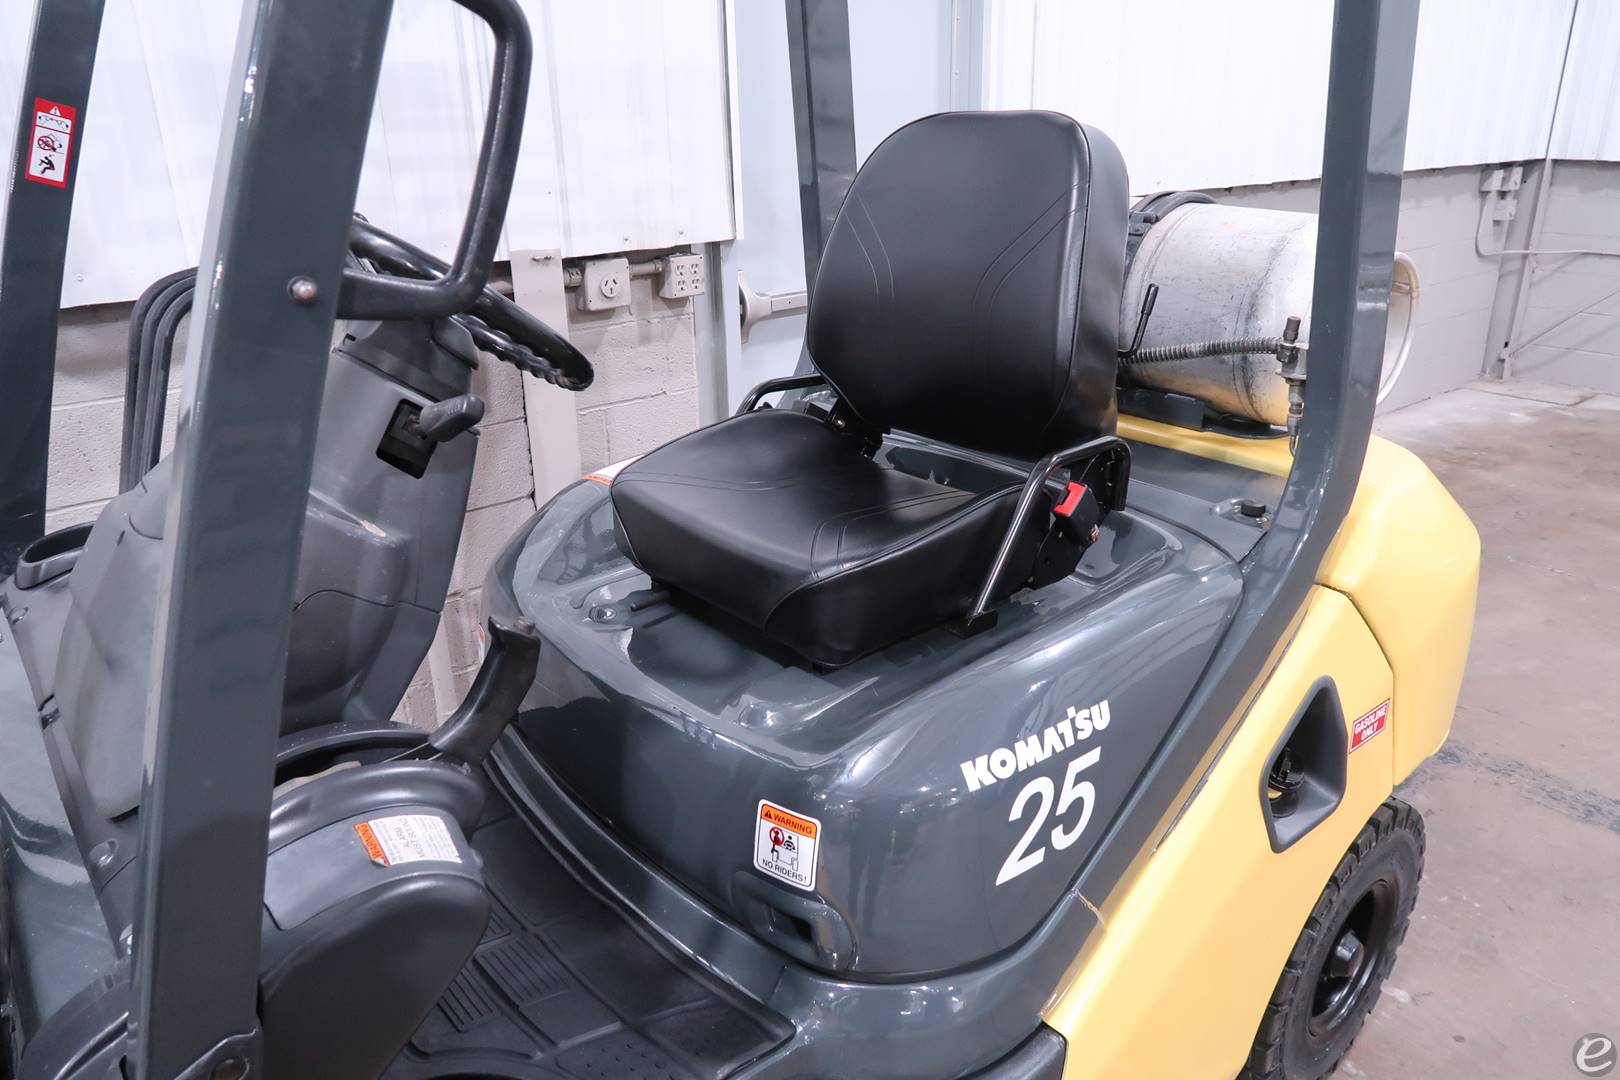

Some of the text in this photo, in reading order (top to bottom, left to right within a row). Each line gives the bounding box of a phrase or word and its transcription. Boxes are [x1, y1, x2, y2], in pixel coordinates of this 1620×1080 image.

[1354, 705, 1388, 734] GASOLINE
[1360, 721, 1379, 741] ONLY
[960, 699, 1111, 793] KOMATSU
[773, 813, 812, 834] WARNING
[995, 746, 1101, 887] 25
[357, 823, 385, 859] WARNING
[762, 858, 774, 869] NO
